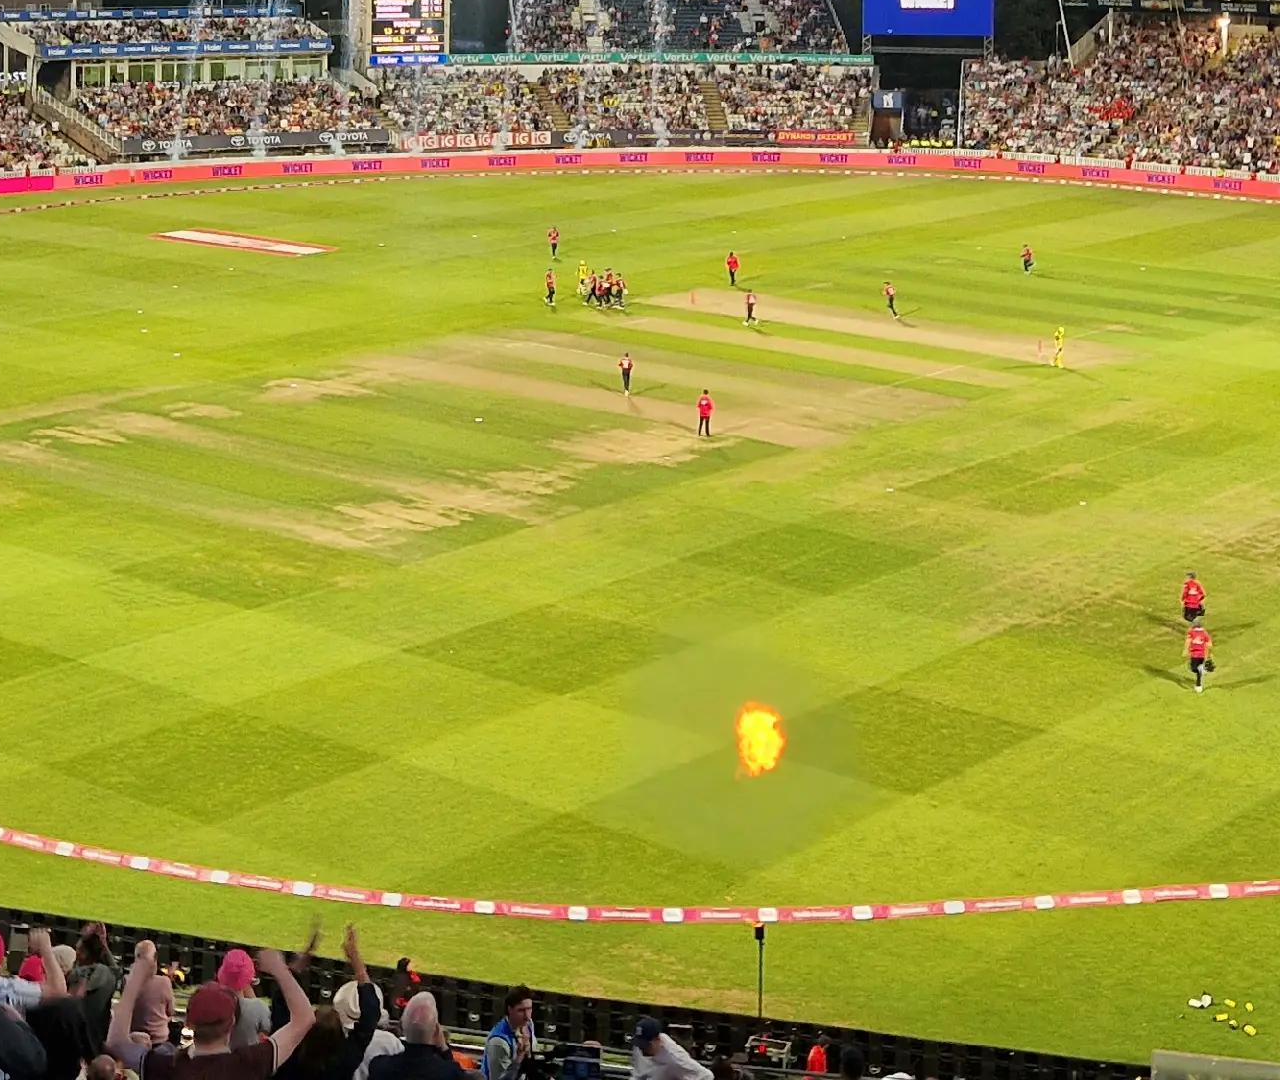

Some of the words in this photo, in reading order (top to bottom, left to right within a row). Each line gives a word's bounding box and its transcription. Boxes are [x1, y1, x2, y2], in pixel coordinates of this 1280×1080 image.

[449, 55, 481, 64] Vertu
[492, 54, 522, 63] Vertu
[534, 54, 565, 63] Vertu
[663, 53, 694, 62] Vertu
[706, 53, 736, 62] Vertu
[247, 135, 282, 145] TOYOTA
[334, 131, 369, 142] TOYOTA
[488, 156, 517, 166] WICKET
[554, 153, 583, 164] WICKET
[619, 152, 649, 163] WICKET
[685, 151, 714, 162] WICKET
[751, 151, 781, 162] WICKET
[819, 152, 849, 163] WICKET
[887, 155, 917, 166] WICKET
[282, 162, 313, 174] WICKET
[352, 159, 383, 171] WICKET
[421, 157, 451, 169] WICKET
[953, 157, 982, 169] WICKET
[1017, 162, 1046, 174] WICKET
[143, 170, 173, 180] WICKET
[212, 165, 243, 177] WICKET
[1081, 167, 1110, 179] WICKET
[74, 174, 103, 186] WICKET
[1147, 173, 1176, 185] WICKET
[1213, 178, 1242, 191] WICKET
